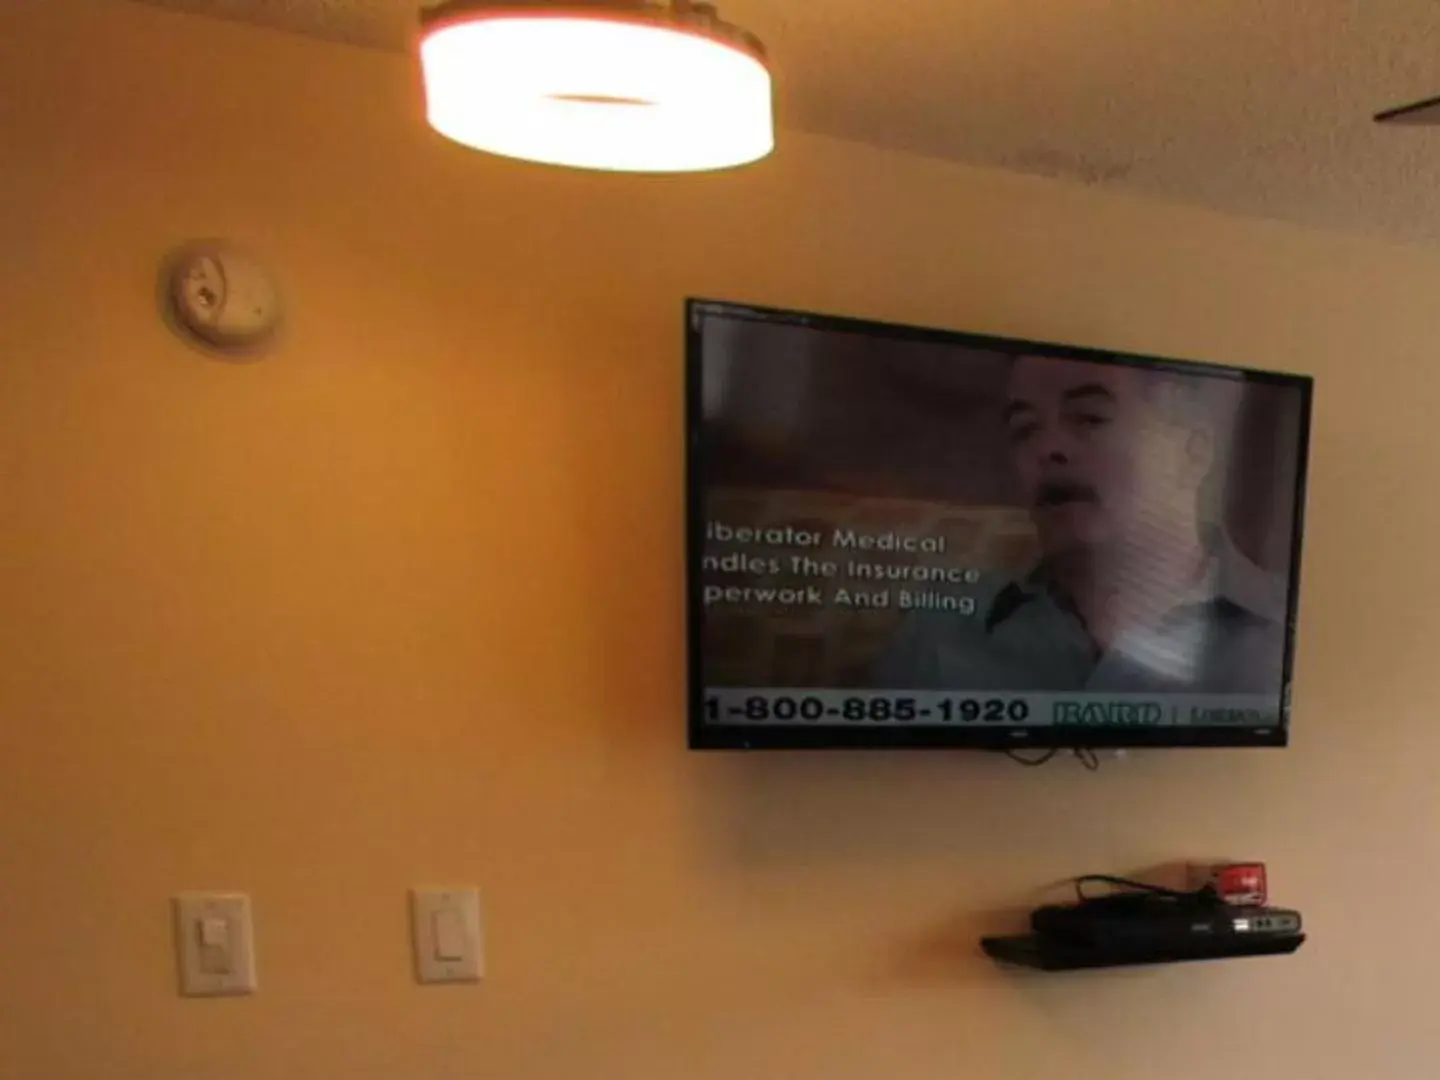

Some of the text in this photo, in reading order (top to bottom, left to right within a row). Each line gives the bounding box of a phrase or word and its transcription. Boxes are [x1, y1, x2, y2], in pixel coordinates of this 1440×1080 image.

[832, 528, 946, 553] Medical
[703, 552, 981, 584] ndles The Insurance
[704, 585, 976, 616] perwork And Billing
[704, 696, 1030, 723] 1-800-885-1920
